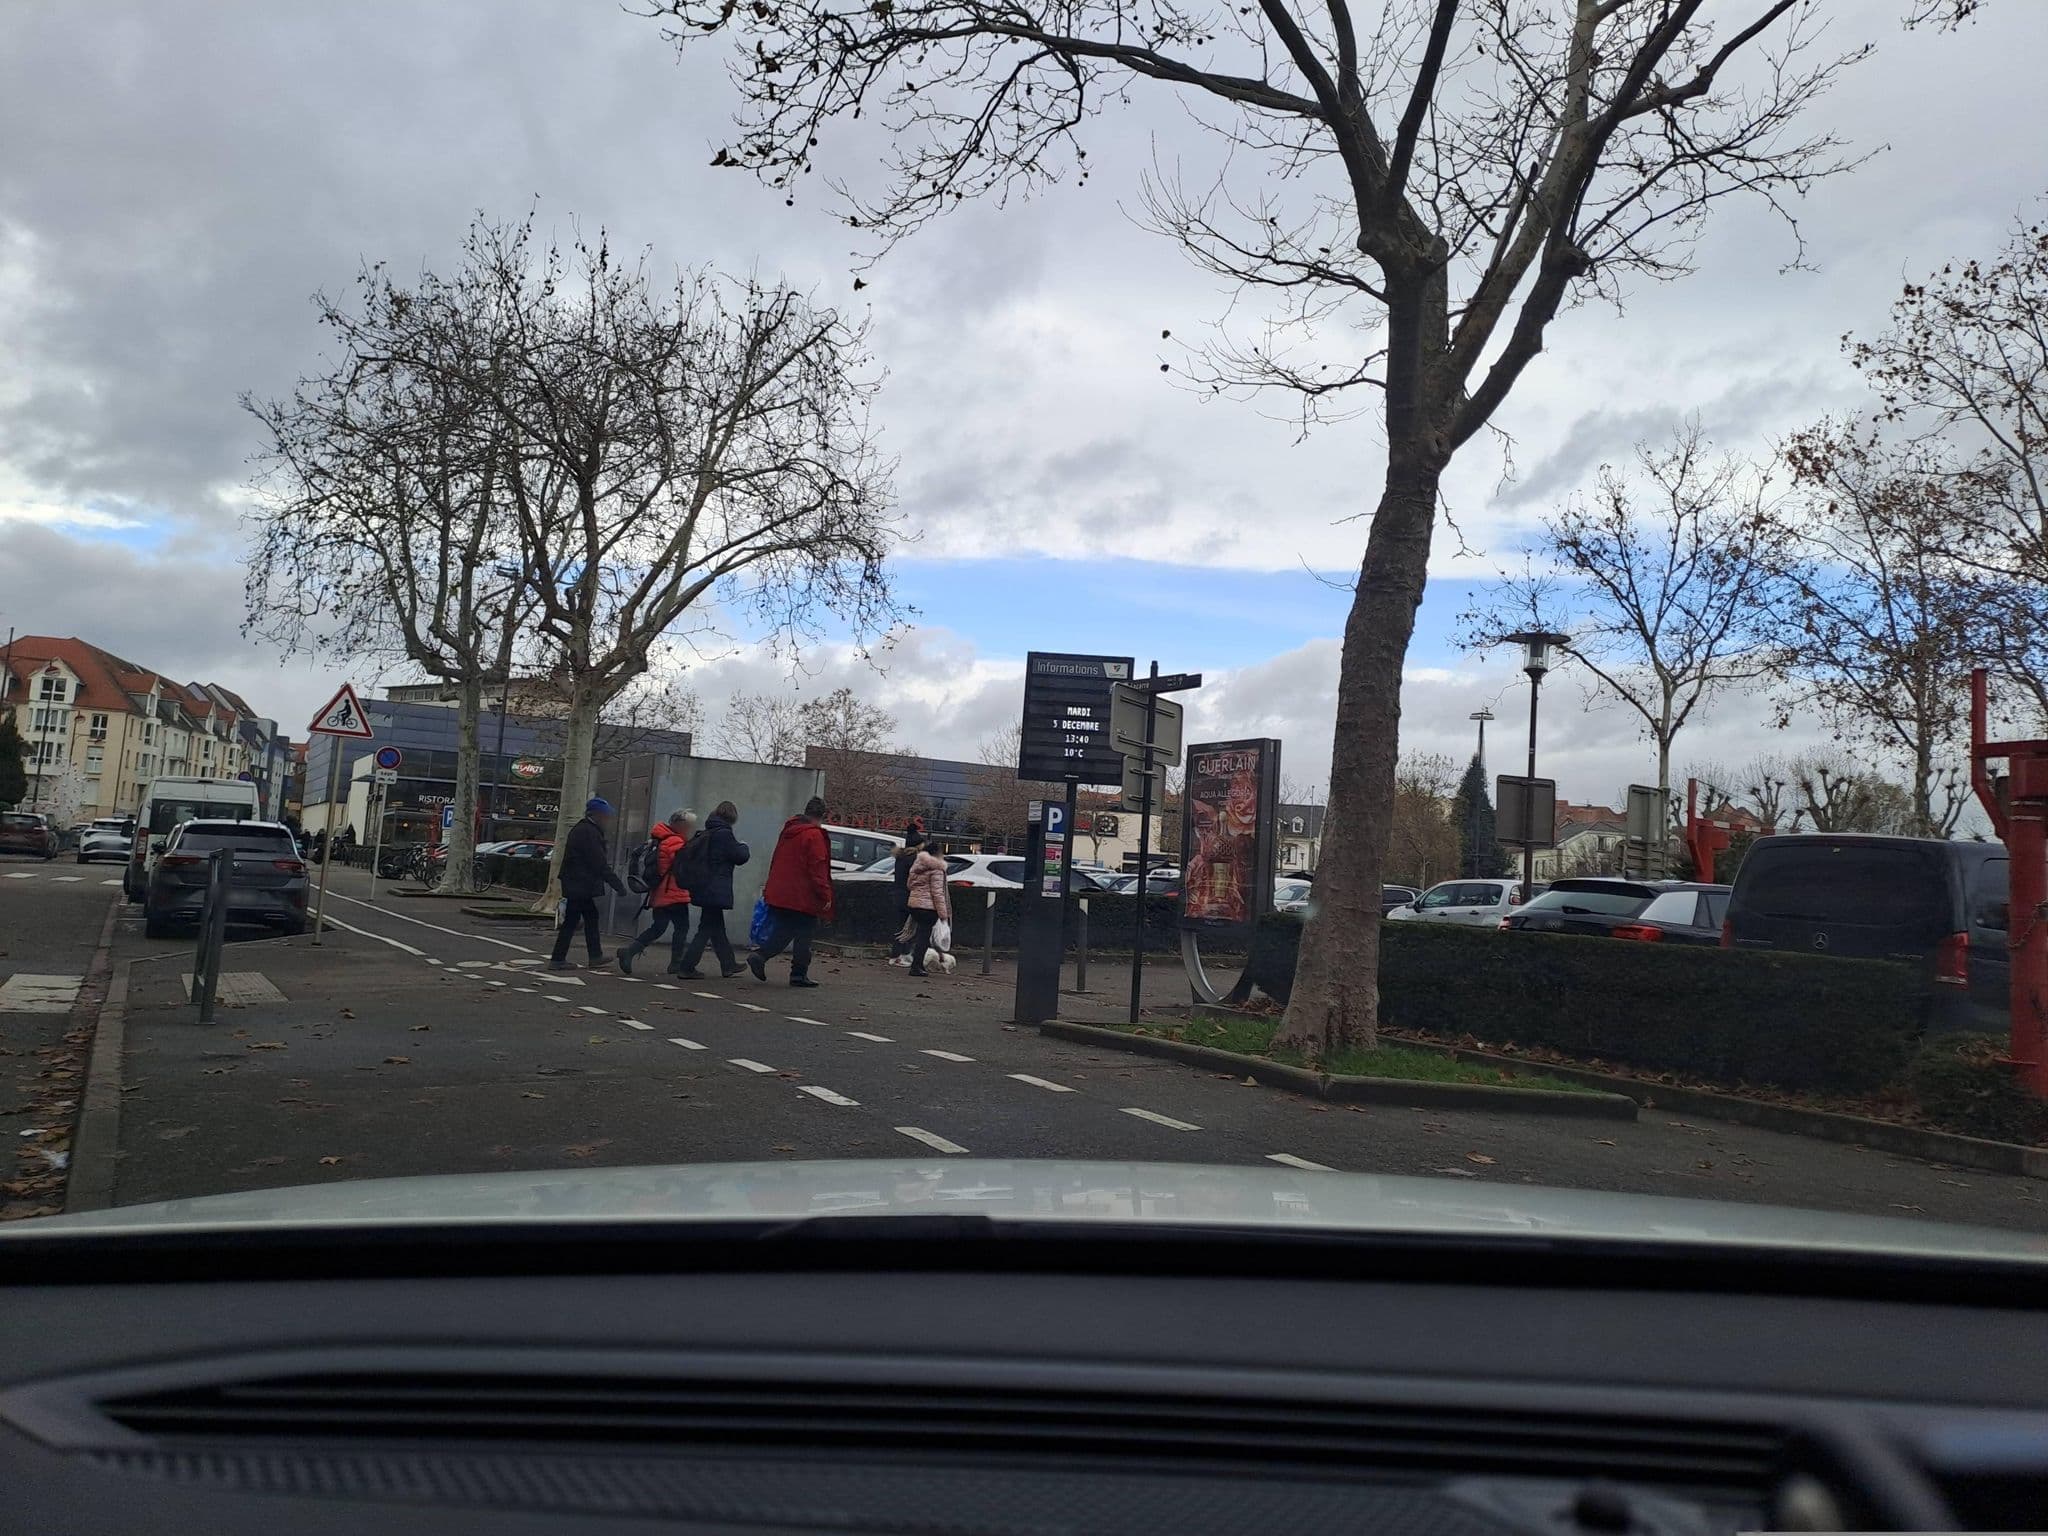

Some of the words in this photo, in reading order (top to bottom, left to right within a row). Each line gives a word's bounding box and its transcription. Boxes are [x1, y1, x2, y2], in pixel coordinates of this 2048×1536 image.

[1037, 661, 1099, 676] Informations
[1067, 706, 1092, 718] MARDI
[1052, 719, 1058, 729] 5
[1062, 720, 1100, 731] DECEMBRE
[1065, 734, 1090, 744] 13:40
[1064, 748, 1084, 758] 10°C
[1197, 755, 1256, 774] GUERLAIN
[535, 804, 559, 812] PIZZA
[1047, 807, 1063, 831] P
